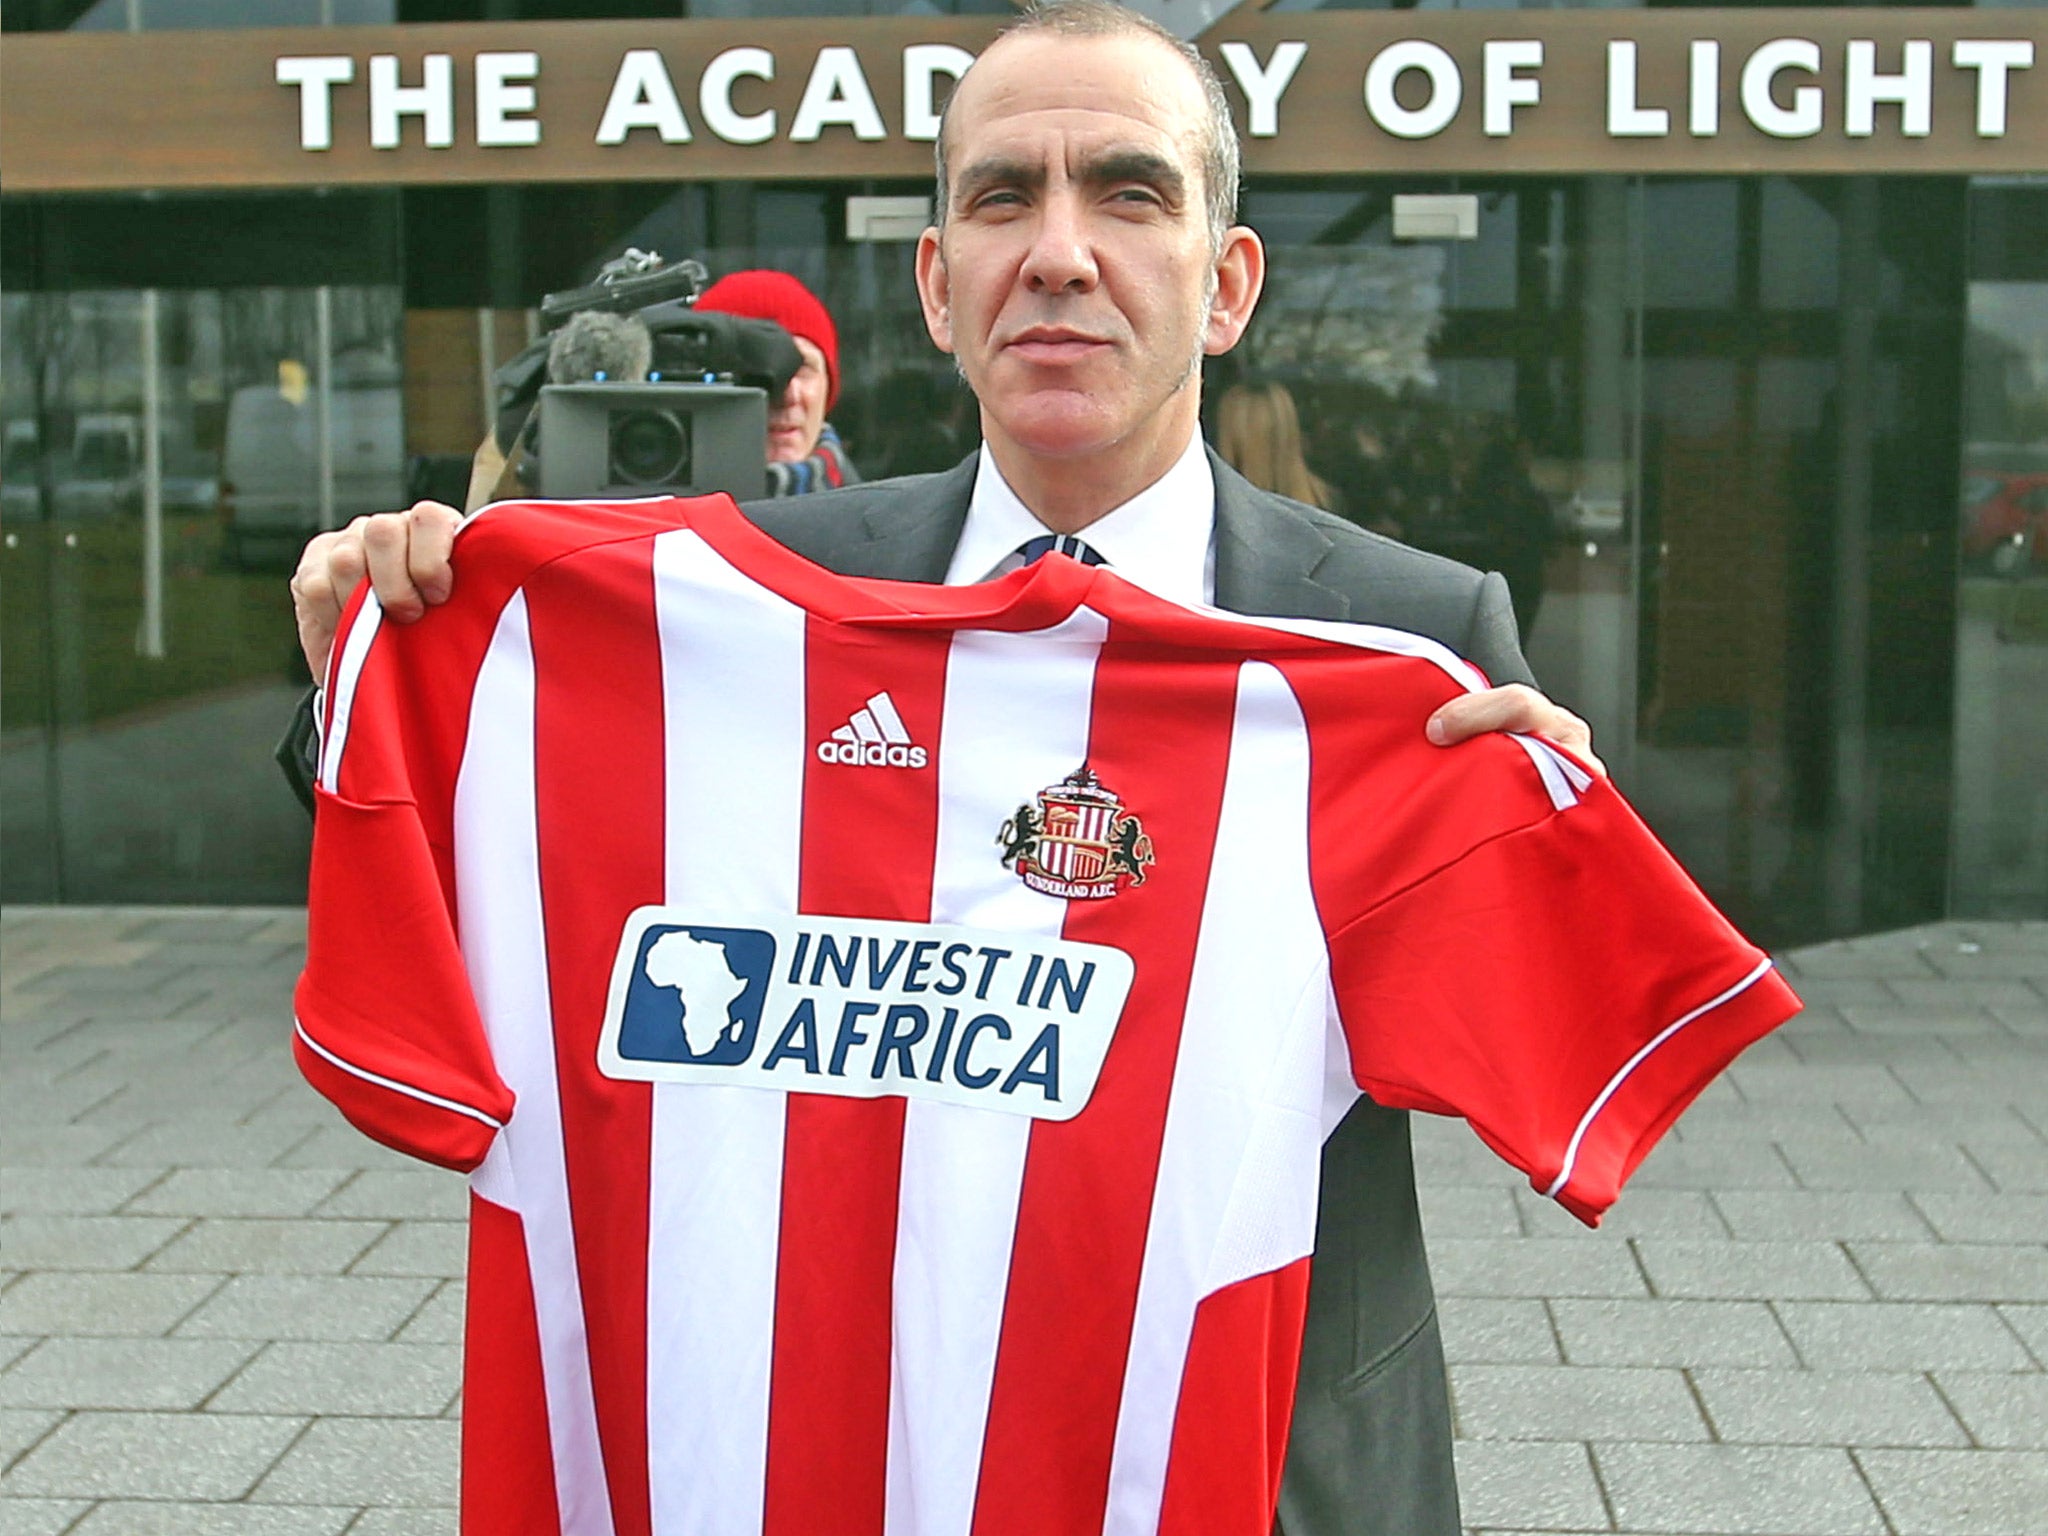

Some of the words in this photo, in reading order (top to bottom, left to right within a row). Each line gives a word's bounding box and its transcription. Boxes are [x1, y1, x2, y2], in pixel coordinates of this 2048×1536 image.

[276, 53, 540, 148] THE
[597, 43, 1306, 141] ACADY
[1364, 41, 1543, 135] OF
[1608, 38, 2034, 135] LIGHT
[817, 740, 928, 769] adidas
[788, 932, 1012, 1000] INVEST
[1016, 953, 1097, 1014] IN
[760, 998, 1062, 1103] AFRICA
